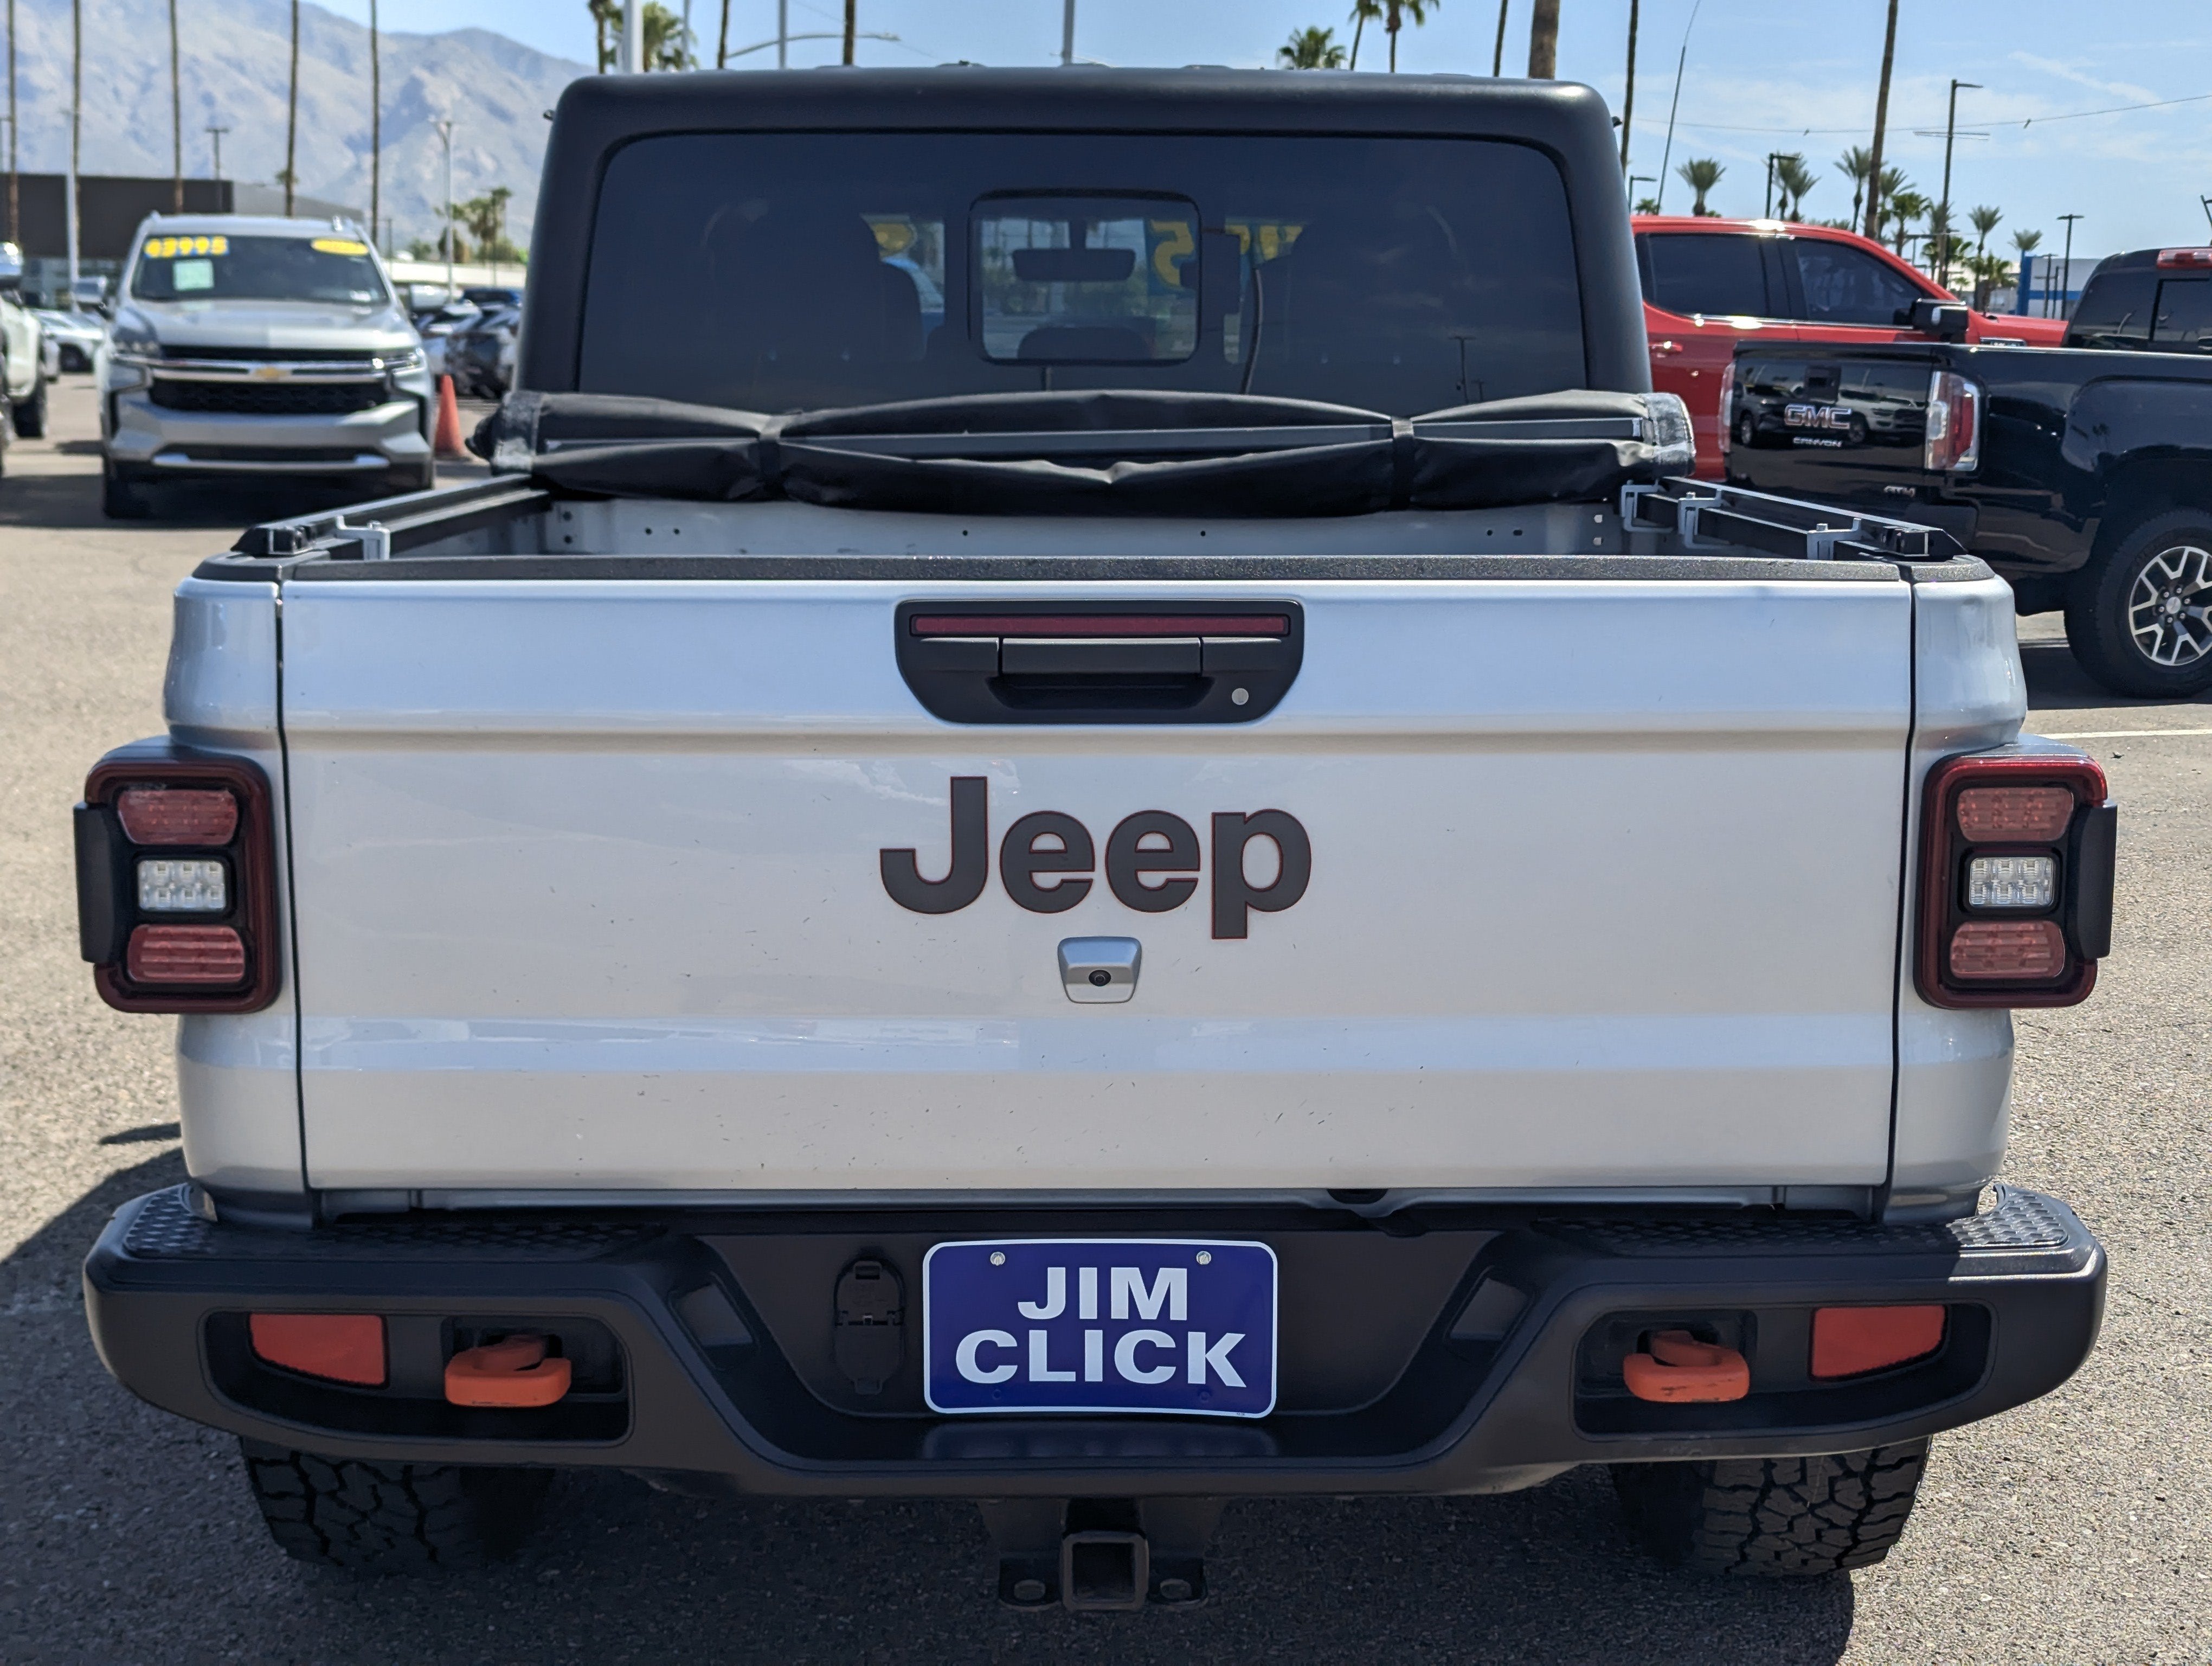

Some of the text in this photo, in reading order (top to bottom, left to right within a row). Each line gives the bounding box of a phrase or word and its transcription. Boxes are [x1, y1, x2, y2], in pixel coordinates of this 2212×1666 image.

[1784, 403, 1852, 429] GMC
[879, 776, 1312, 940] Jeep
[1017, 1267, 1187, 1321] JIM
[955, 1329, 1247, 1388] CLICK
